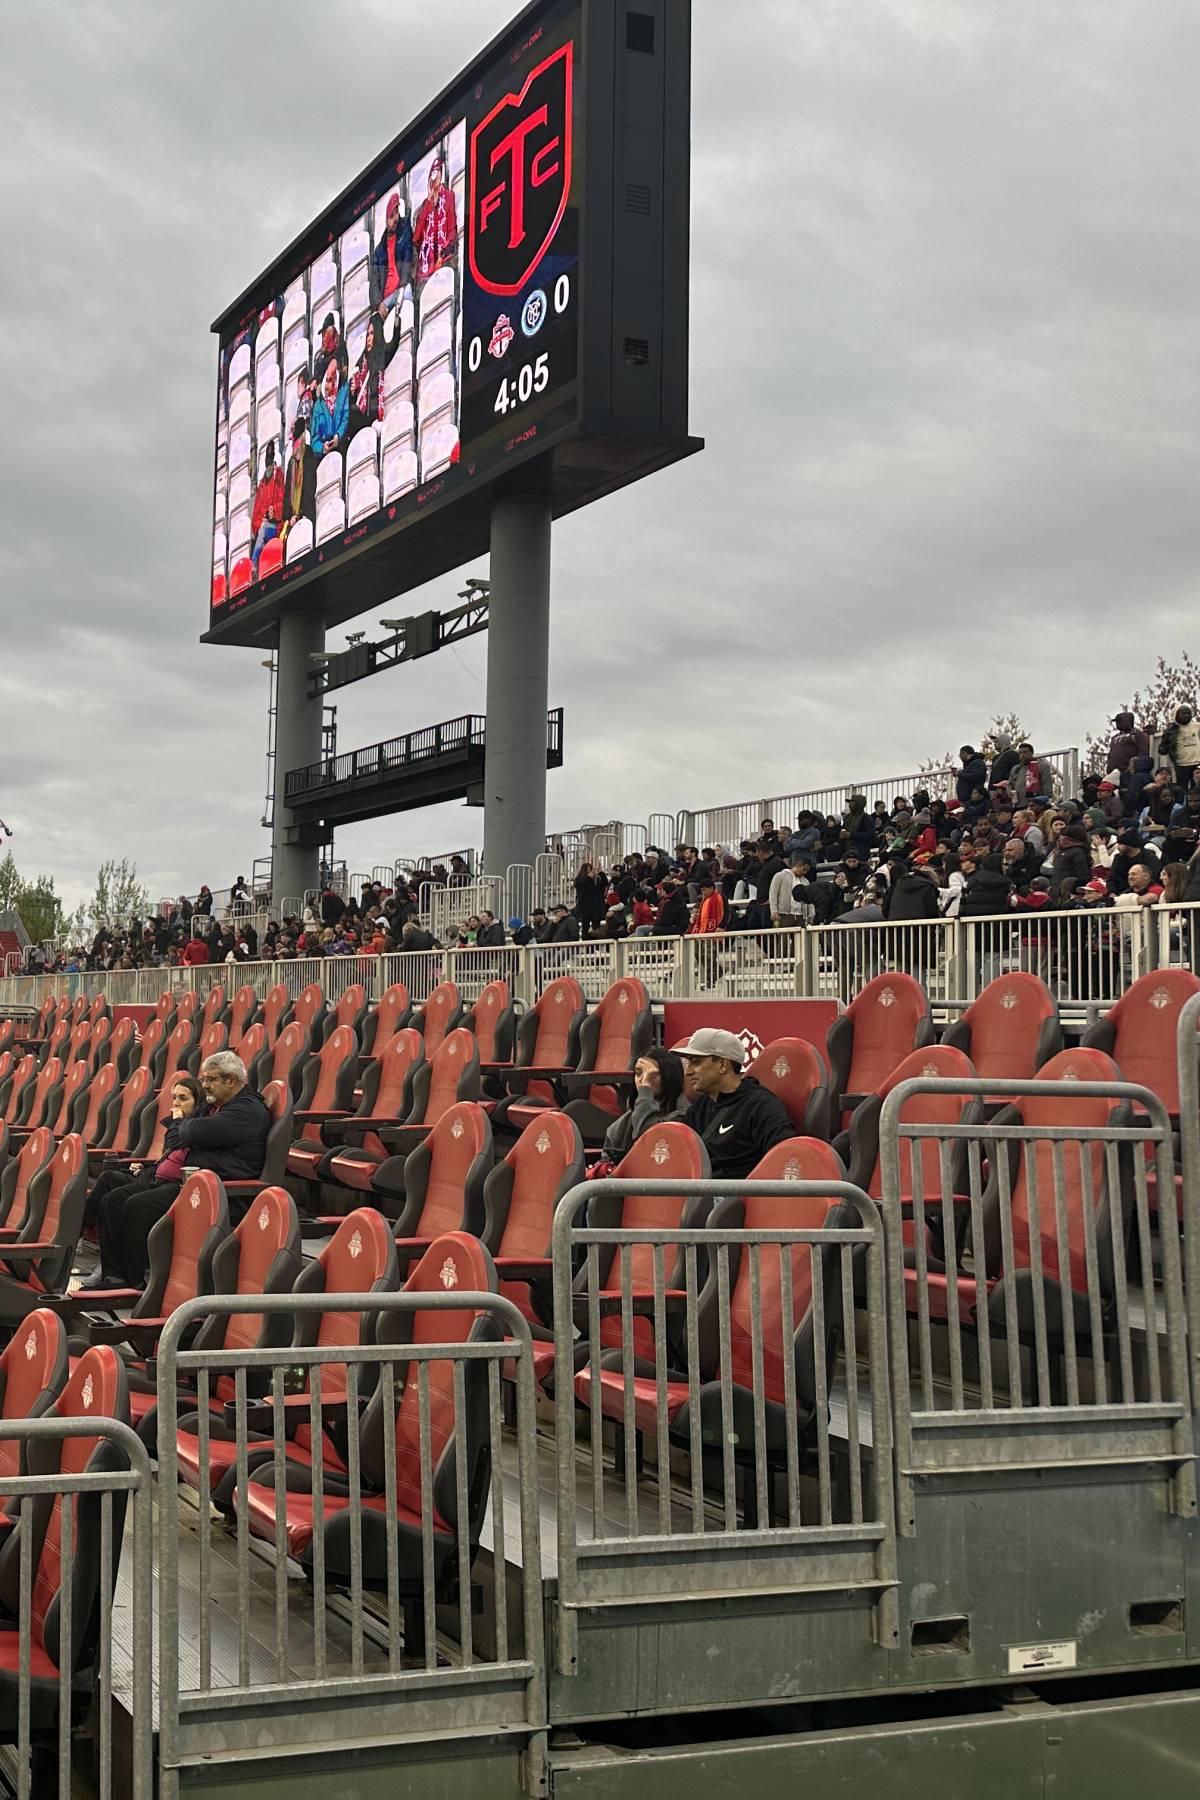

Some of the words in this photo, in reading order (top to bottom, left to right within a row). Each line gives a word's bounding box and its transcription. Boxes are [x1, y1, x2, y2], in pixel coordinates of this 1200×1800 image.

[554, 274, 570, 313] 0
[468, 336, 482, 372] 0
[494, 352, 549, 415] 4:05
